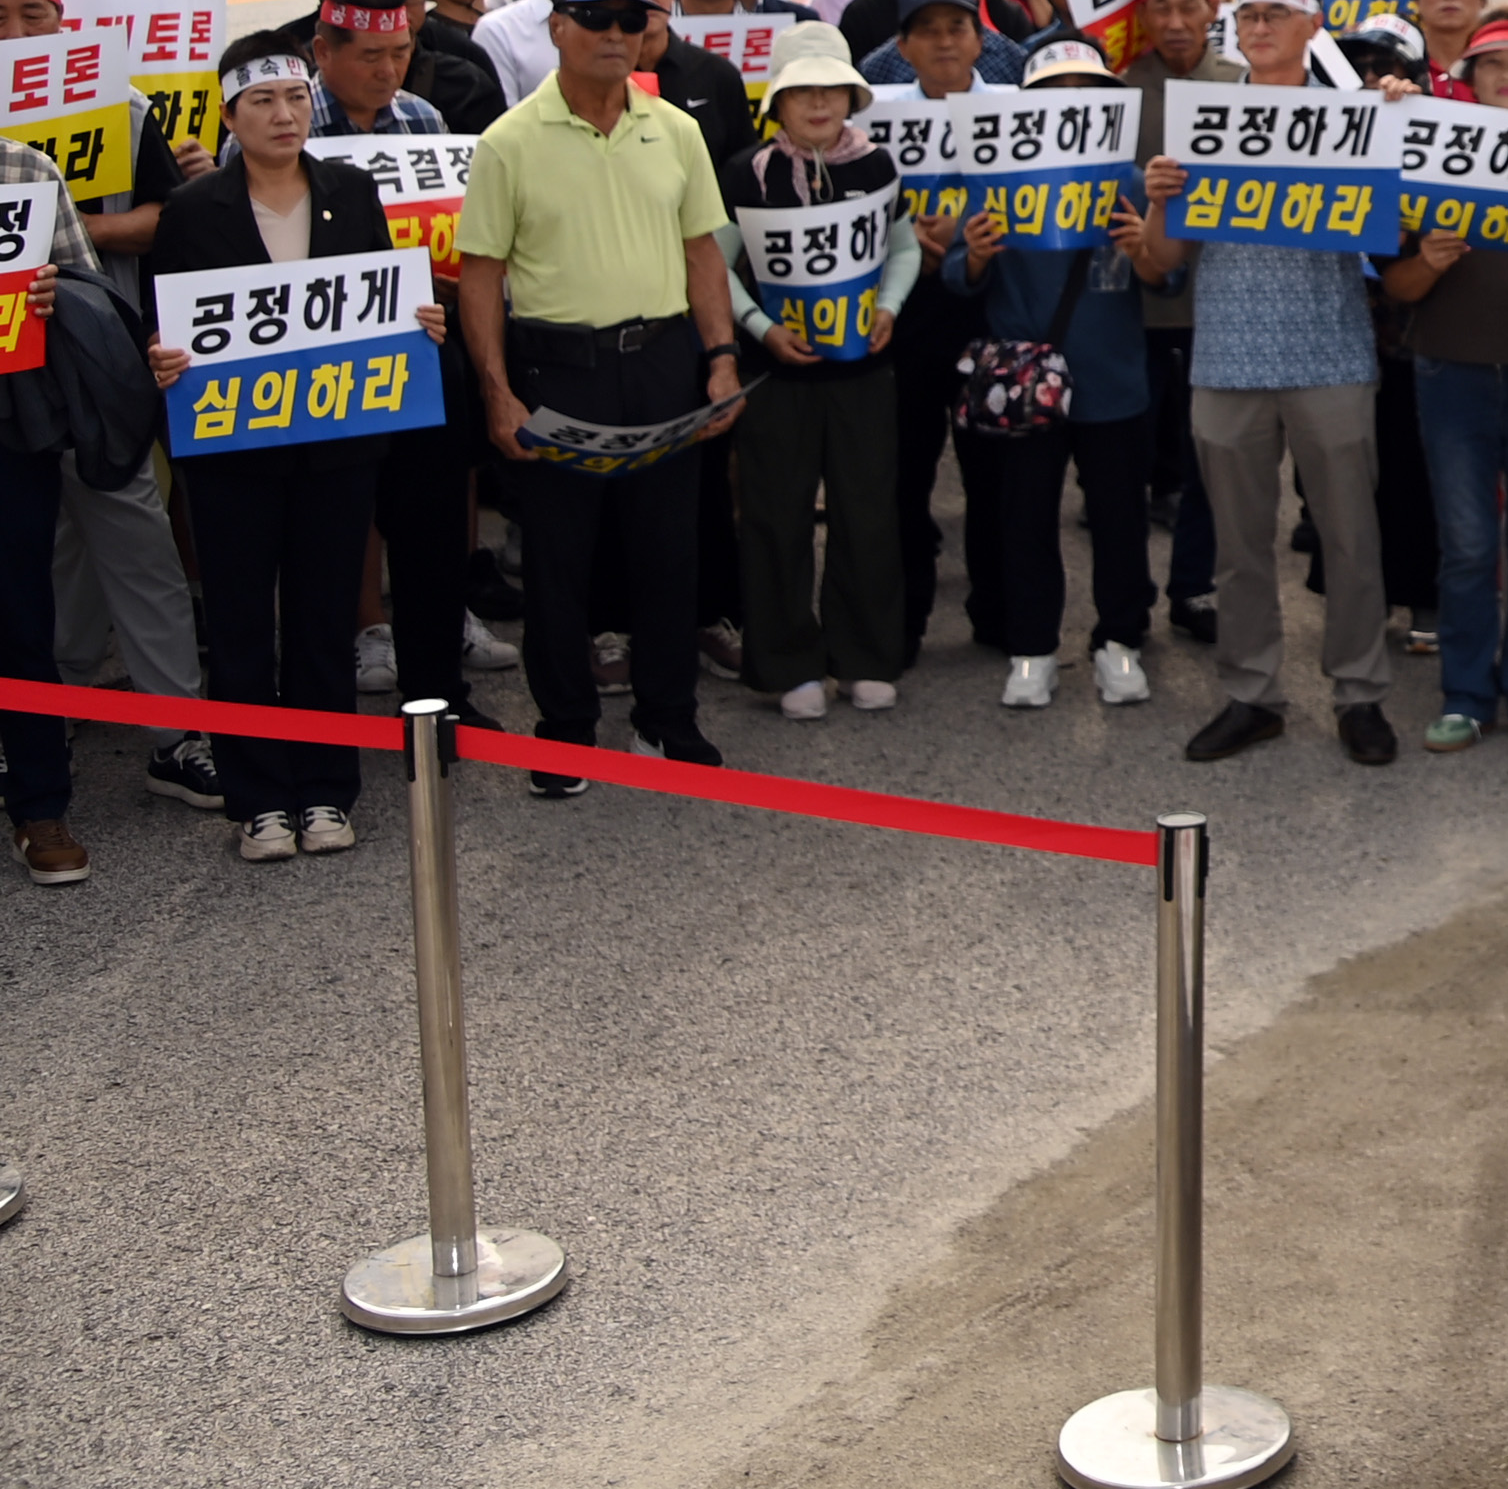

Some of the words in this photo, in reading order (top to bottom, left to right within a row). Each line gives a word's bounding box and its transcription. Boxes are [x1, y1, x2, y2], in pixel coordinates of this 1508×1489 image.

[972, 102, 1125, 165] 공정하게
[1190, 105, 1378, 157] 공정하게
[984, 180, 1119, 236] 심의하라
[1184, 177, 1373, 236] 심의하라
[191, 266, 401, 355] 공정하게
[193, 353, 409, 441] 심의하라
